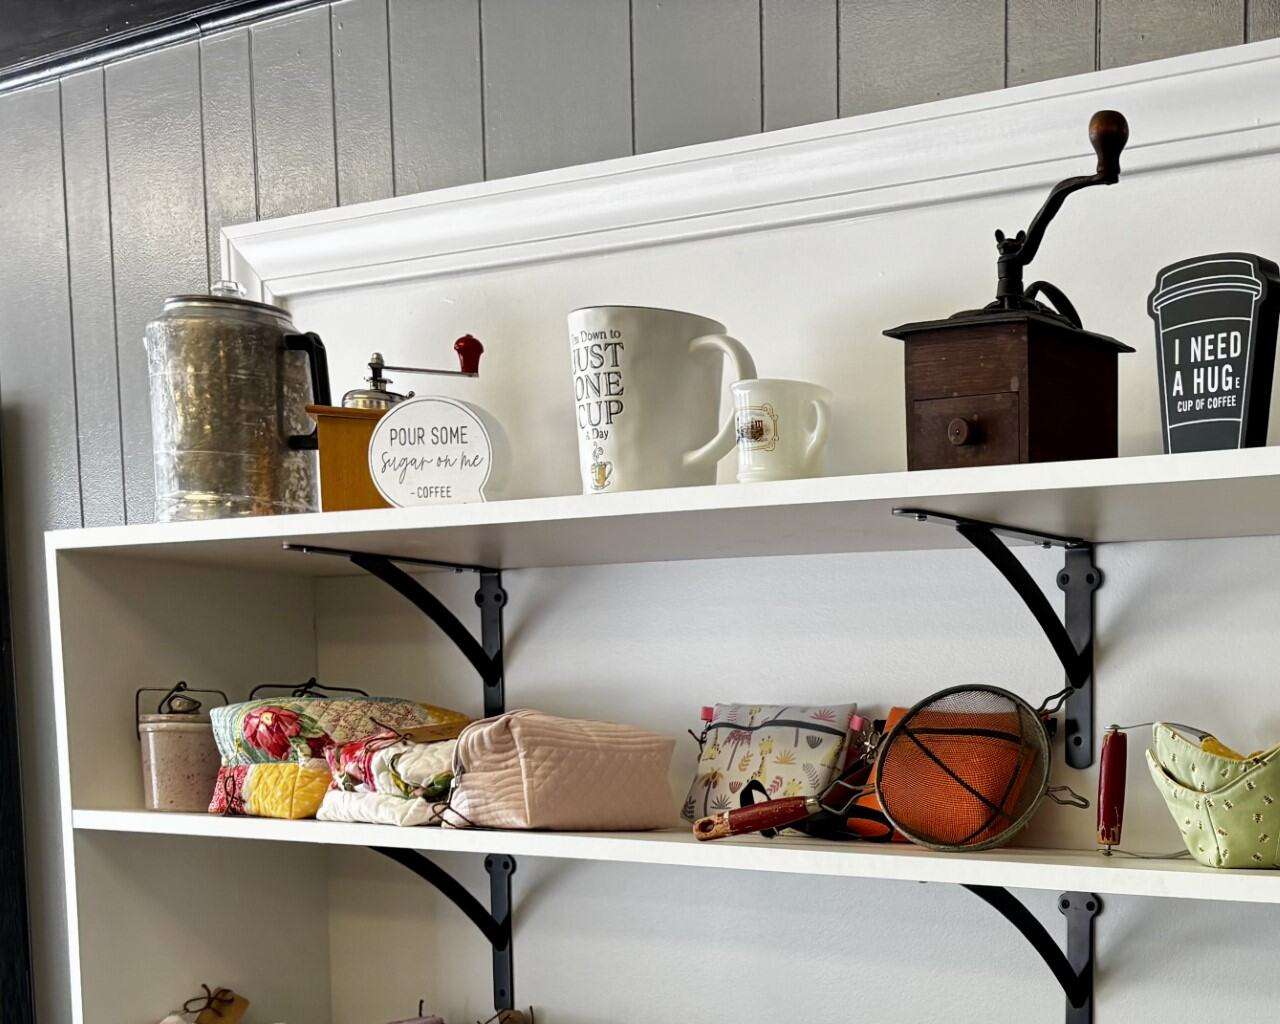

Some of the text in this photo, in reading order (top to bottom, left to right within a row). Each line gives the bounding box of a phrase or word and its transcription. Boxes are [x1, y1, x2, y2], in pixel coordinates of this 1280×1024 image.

[581, 330, 608, 342] Down
[610, 329, 622, 339] to
[572, 342, 625, 374] JUST
[1174, 331, 1242, 365] I NEED
[575, 371, 625, 402] ONE
[1172, 371, 1184, 397] A
[578, 399, 624, 429] CUP
[1177, 395, 1237, 413] CUP OF COFFEE
[390, 425, 468, 447] POUR SOME
[592, 428, 609, 440] Day
[436, 455, 457, 468] on
